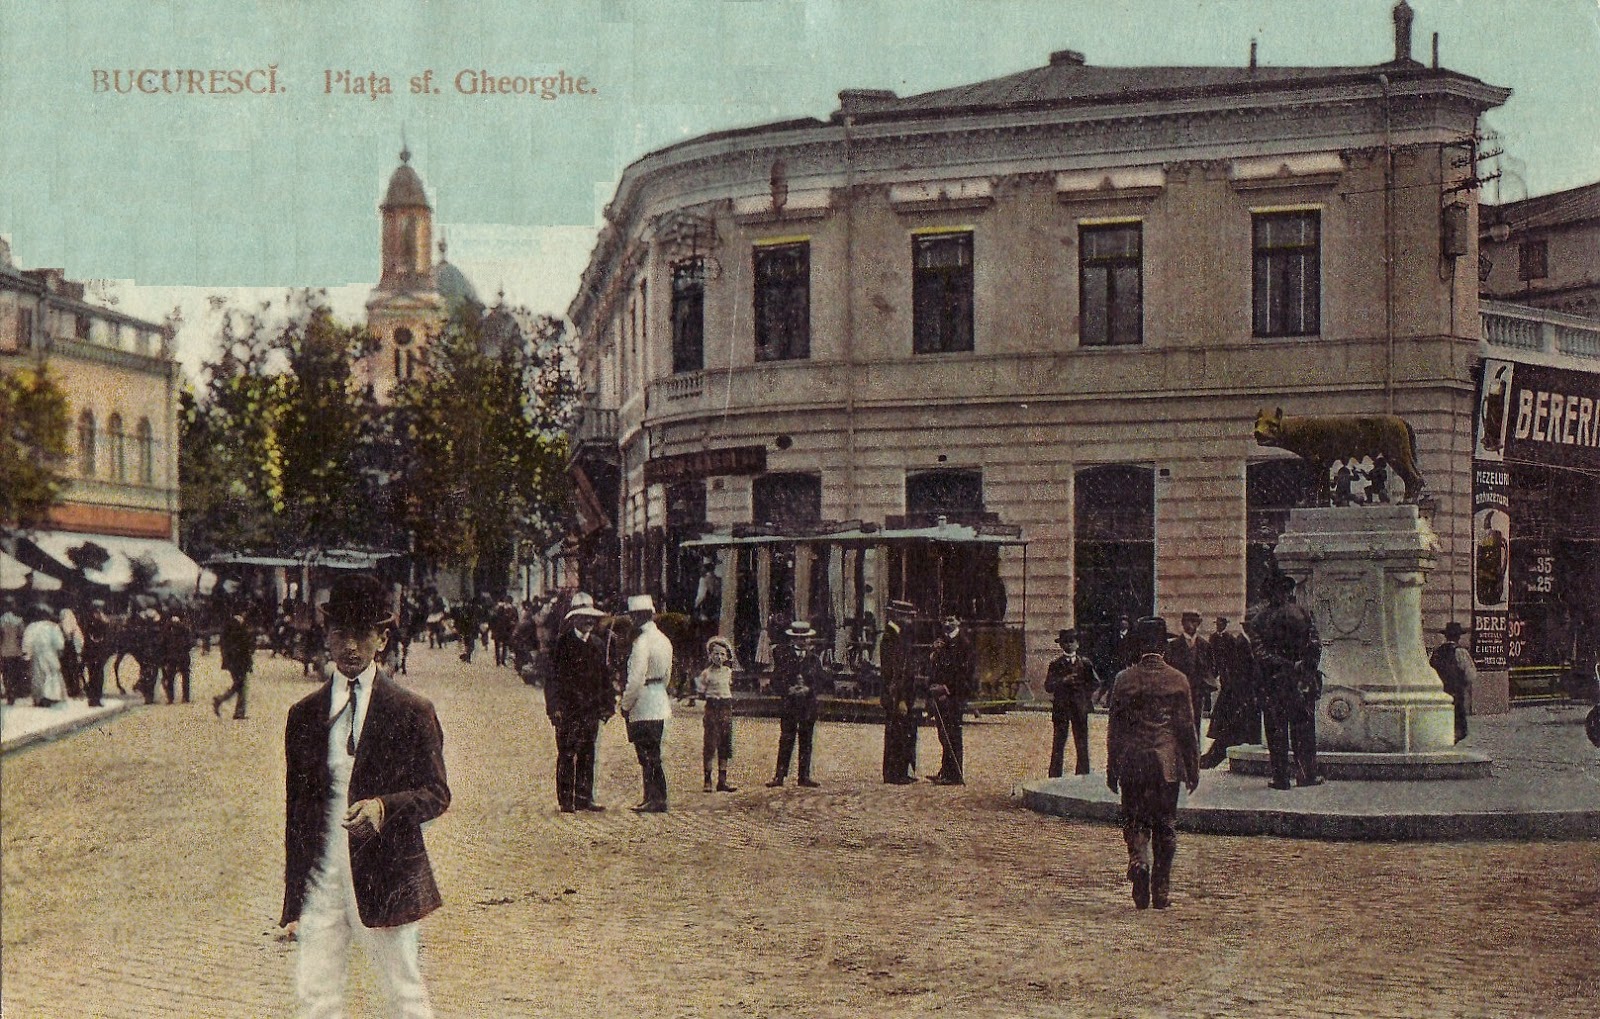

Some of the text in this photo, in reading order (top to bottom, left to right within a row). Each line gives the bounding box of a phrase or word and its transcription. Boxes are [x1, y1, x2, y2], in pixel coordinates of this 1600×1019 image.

[1514, 388, 1600, 447] BERERI
[1475, 615, 1507, 631] BERE
[1508, 620, 1521, 638] 30
[1508, 640, 1521, 657] 20
